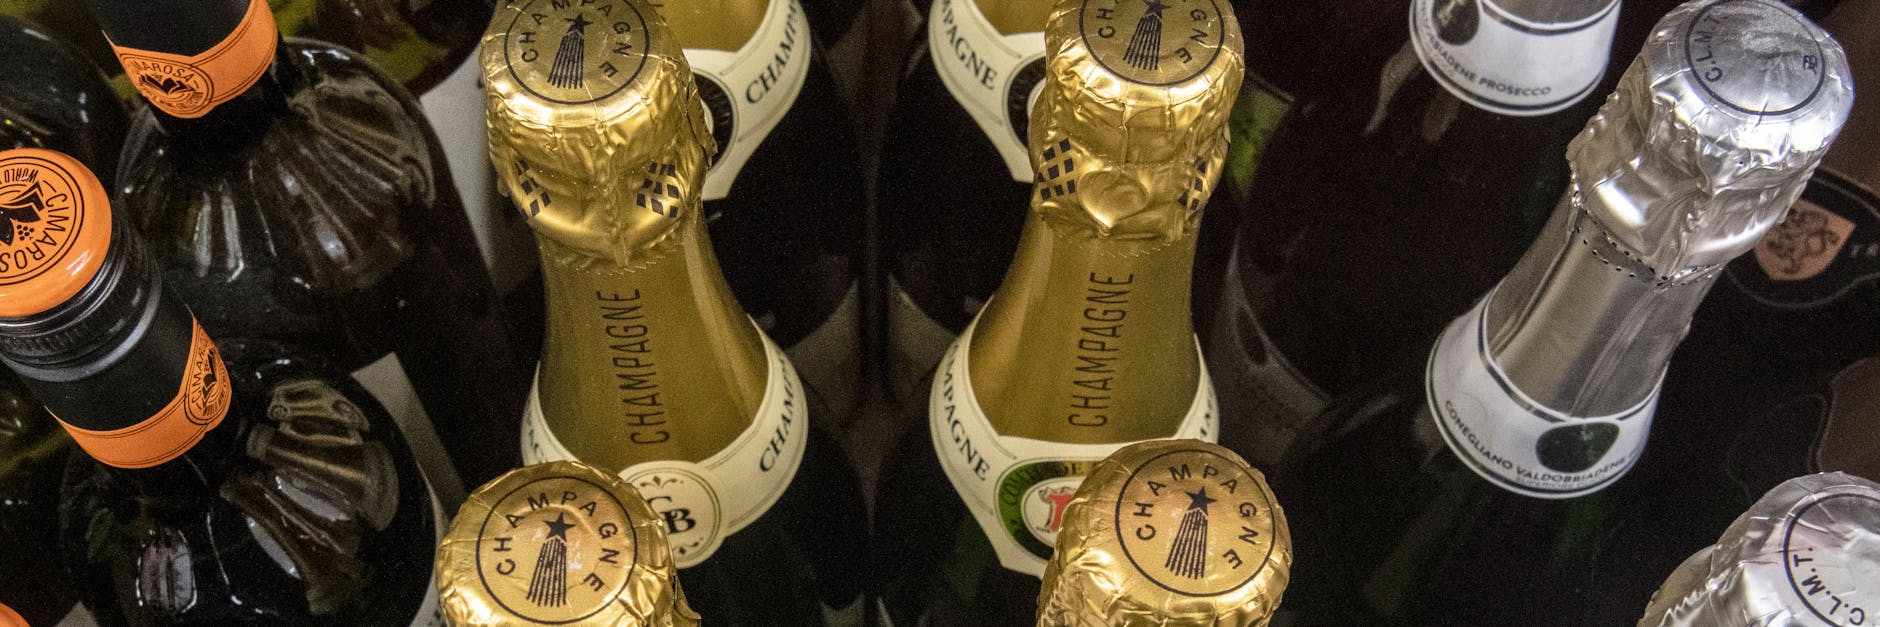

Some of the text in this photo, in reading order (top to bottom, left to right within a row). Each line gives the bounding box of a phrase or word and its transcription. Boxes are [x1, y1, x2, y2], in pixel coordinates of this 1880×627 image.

[1479, 77, 1552, 97] PROSECCO
[4, 167, 39, 184] WORLD
[0, 192, 70, 273] CIMAROS
[596, 288, 671, 445] CHAMPAGNE
[1067, 271, 1134, 428] CHAMPAGNE
[1445, 401, 1626, 483] CONEGLIANO VALDOBBIADENE
[492, 490, 620, 592] CHAMPAGNE
[1132, 462, 1261, 571] CHAMPAGNE
